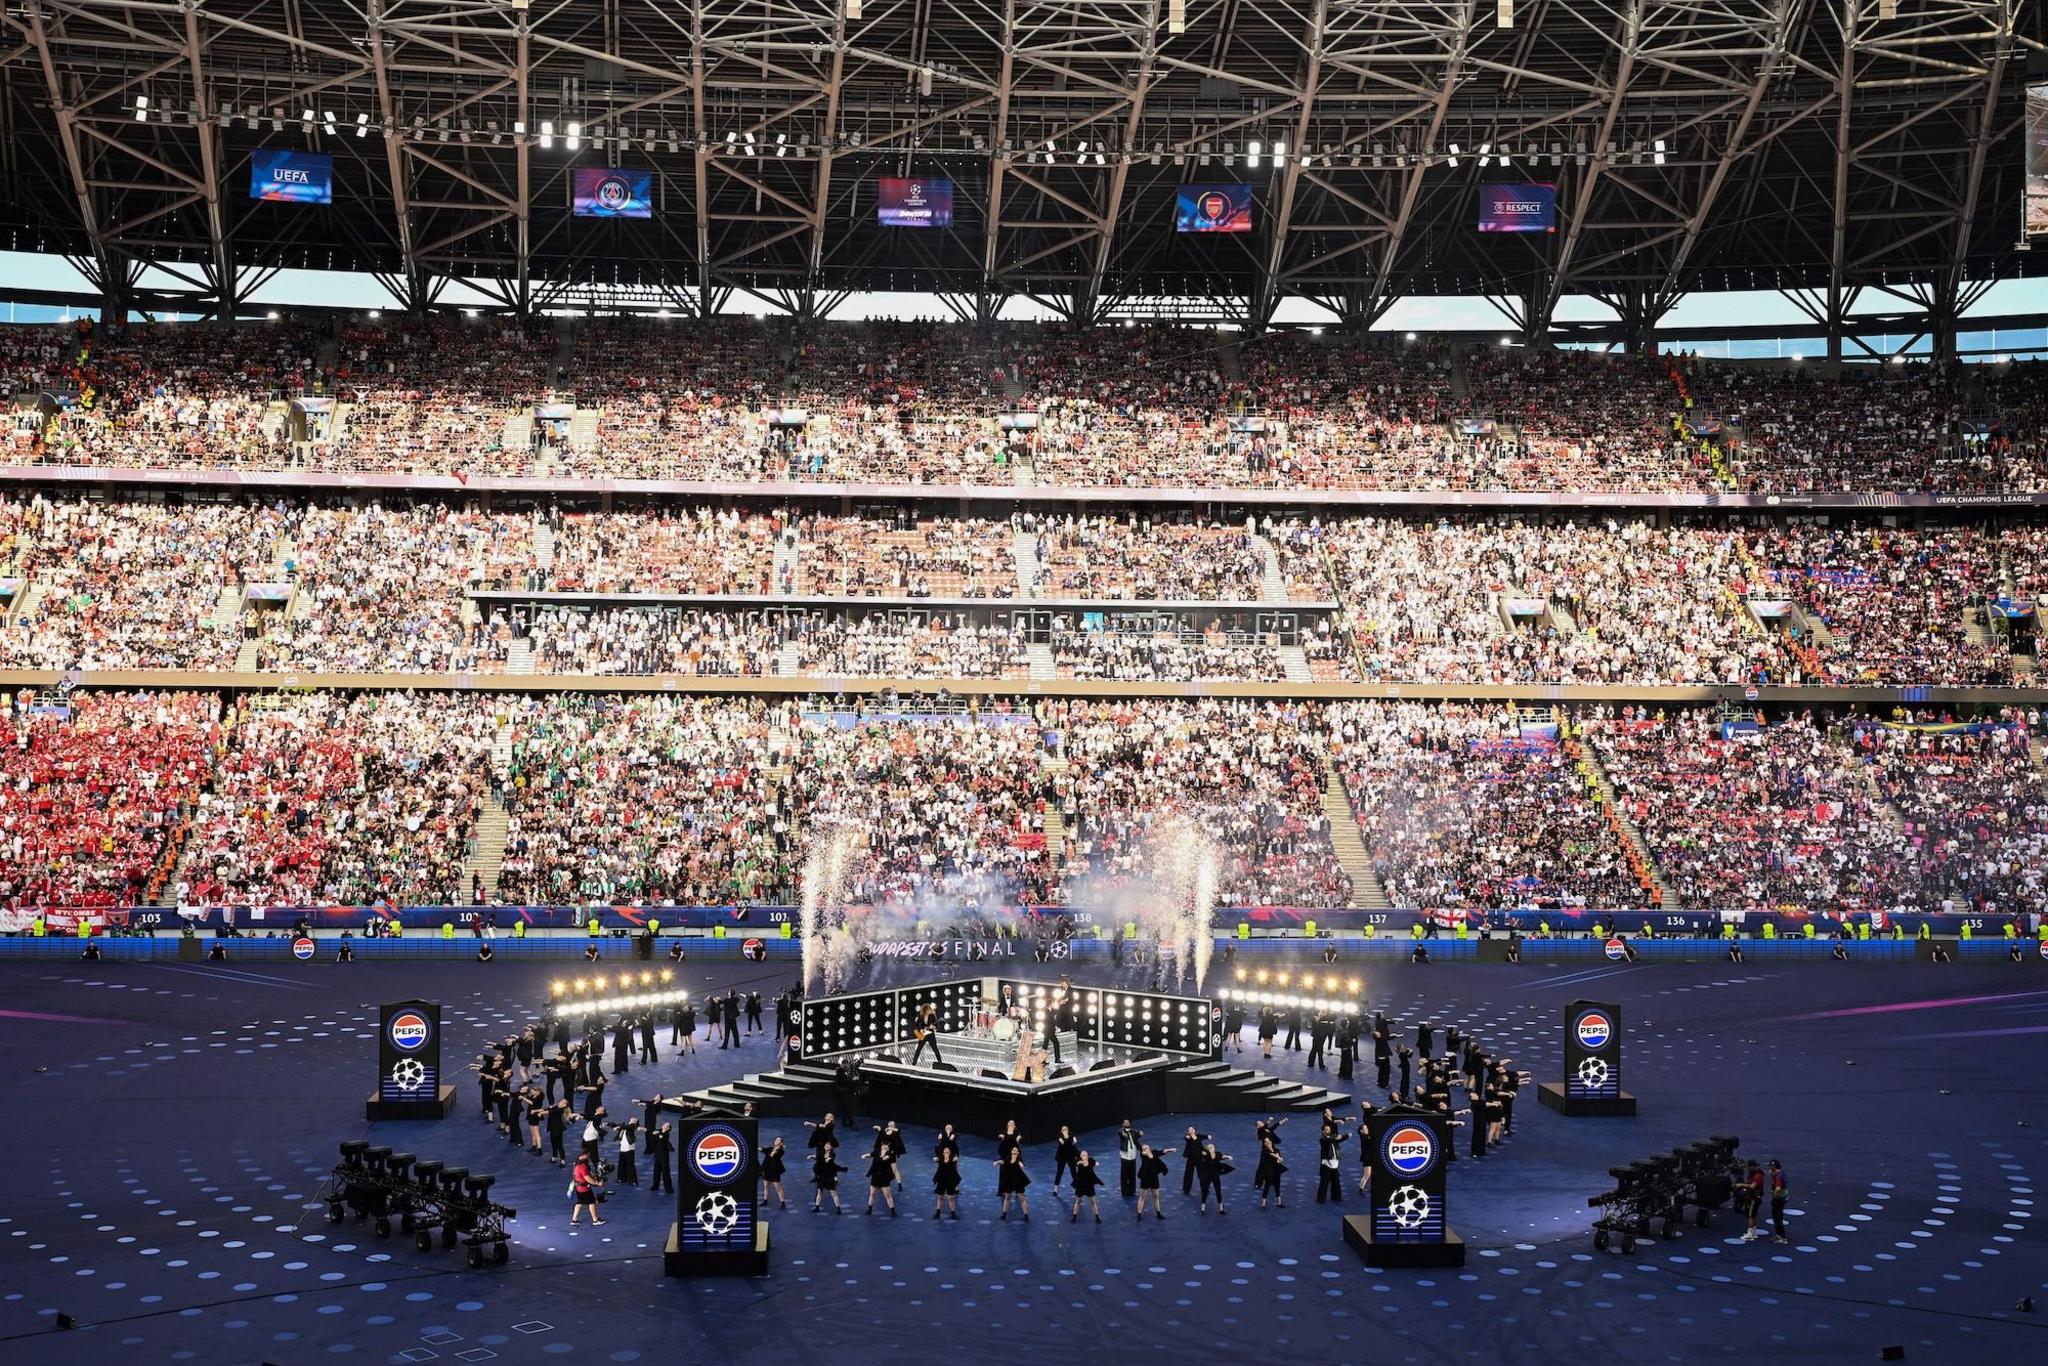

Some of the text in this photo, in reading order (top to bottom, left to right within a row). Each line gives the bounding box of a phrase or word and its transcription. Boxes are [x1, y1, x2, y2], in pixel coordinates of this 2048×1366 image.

[274, 169, 309, 183] UEFA
[1505, 204, 1541, 212] RESPECT
[141, 913, 161, 923] 103
[1073, 913, 1092, 923] 138
[1368, 914, 1387, 924] 137
[1666, 916, 1685, 926] 136
[955, 941, 1016, 956] FINAL
[395, 1027, 424, 1035] PEPSI
[1391, 1145, 1428, 1154] PEPSI
[698, 1151, 737, 1160] PEPSI
